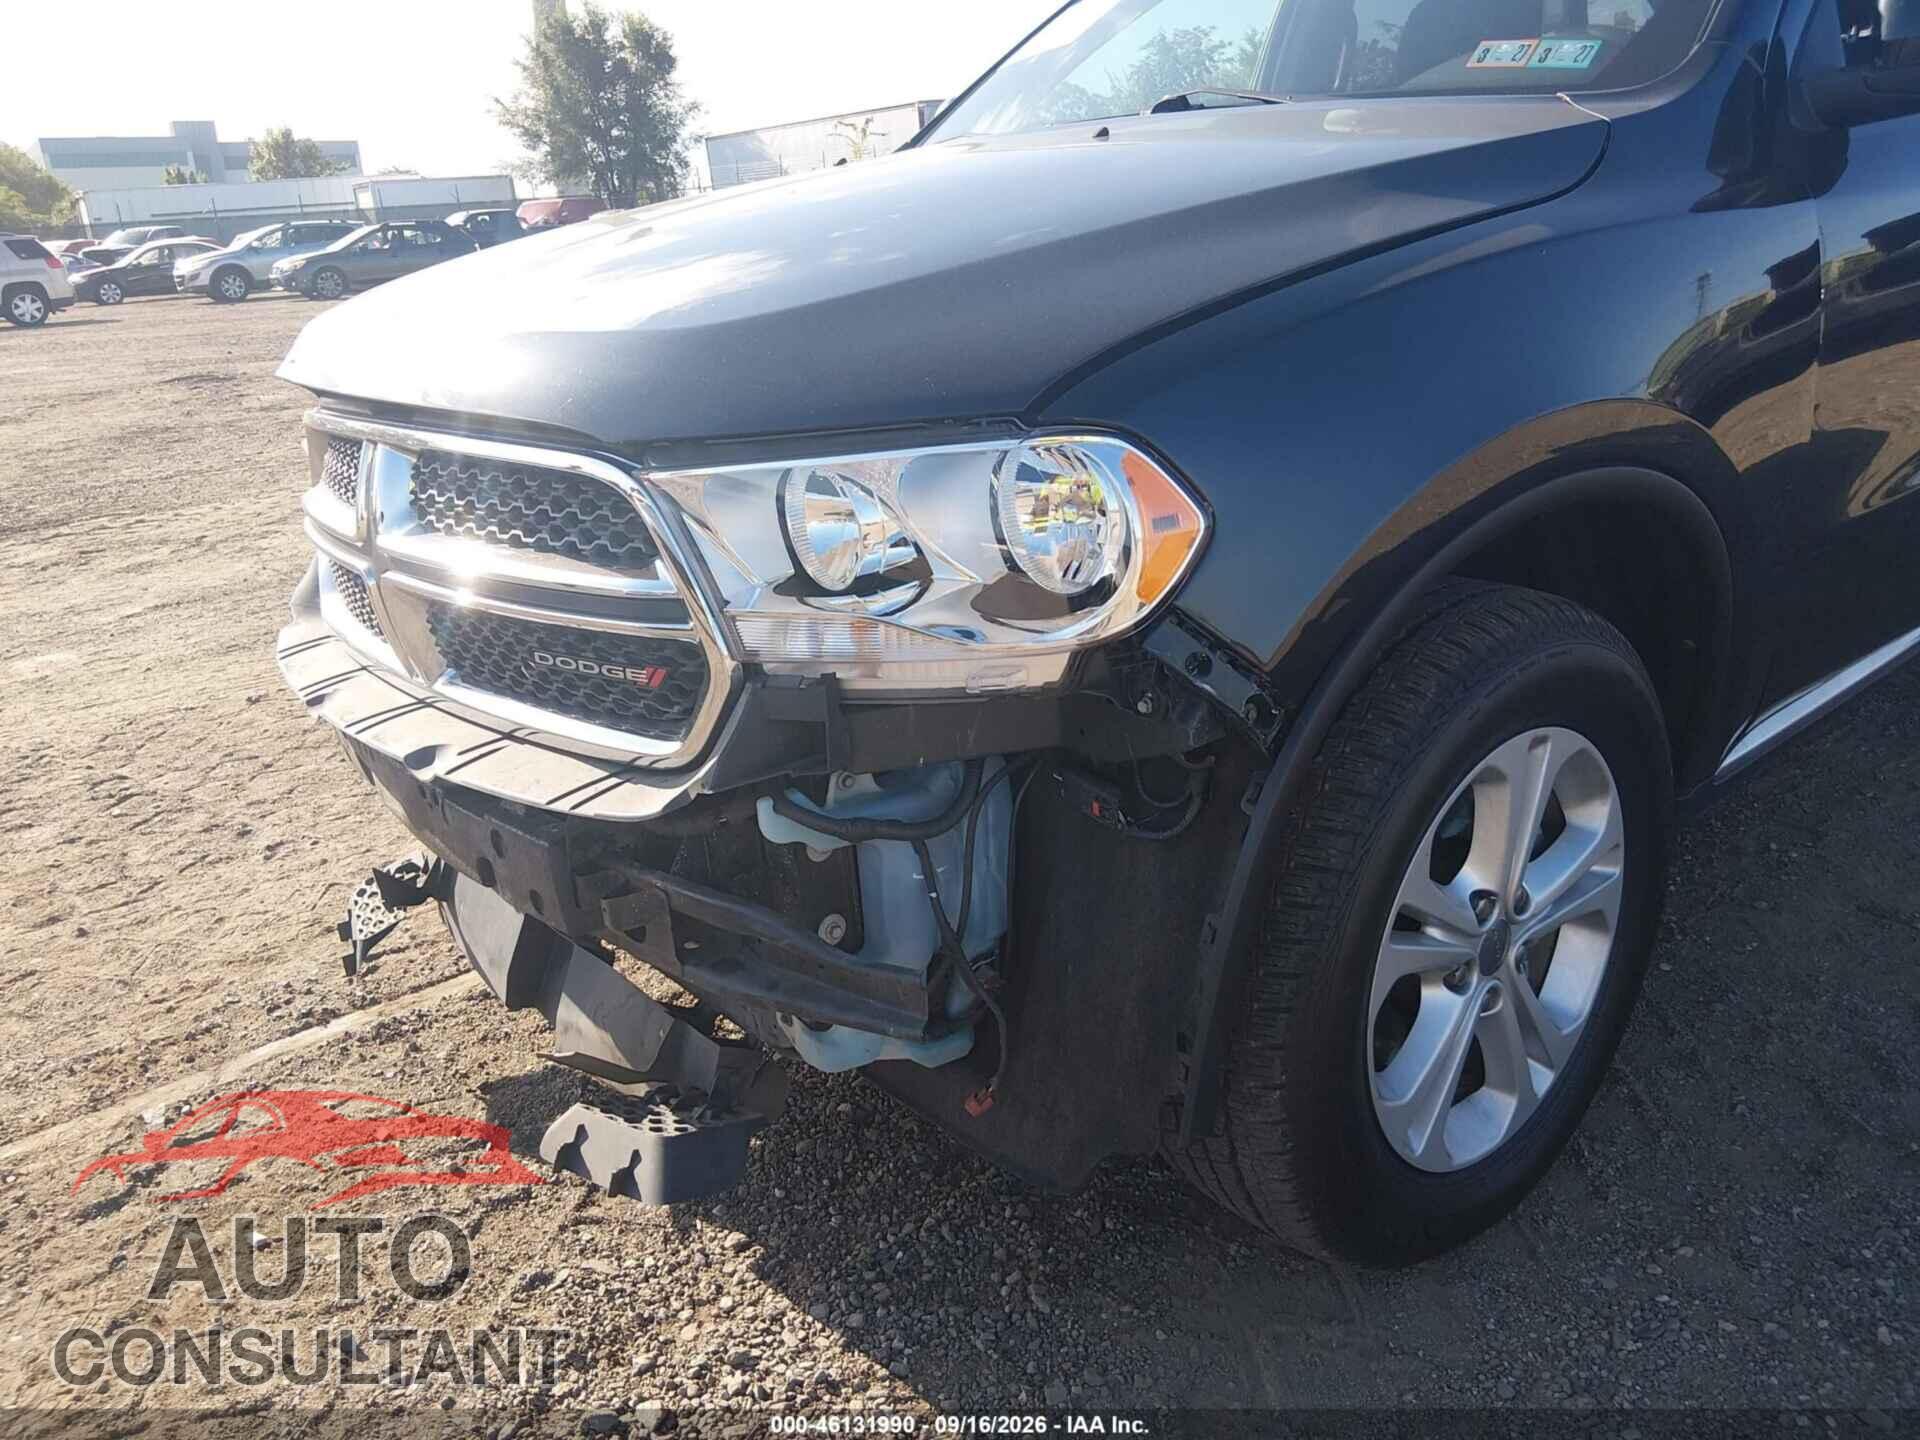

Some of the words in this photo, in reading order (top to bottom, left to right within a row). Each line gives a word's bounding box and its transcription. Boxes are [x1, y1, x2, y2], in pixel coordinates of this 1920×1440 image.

[1511, 44, 1532, 62] 27
[1573, 45, 1594, 63] 27
[534, 652, 649, 682] DODGE
